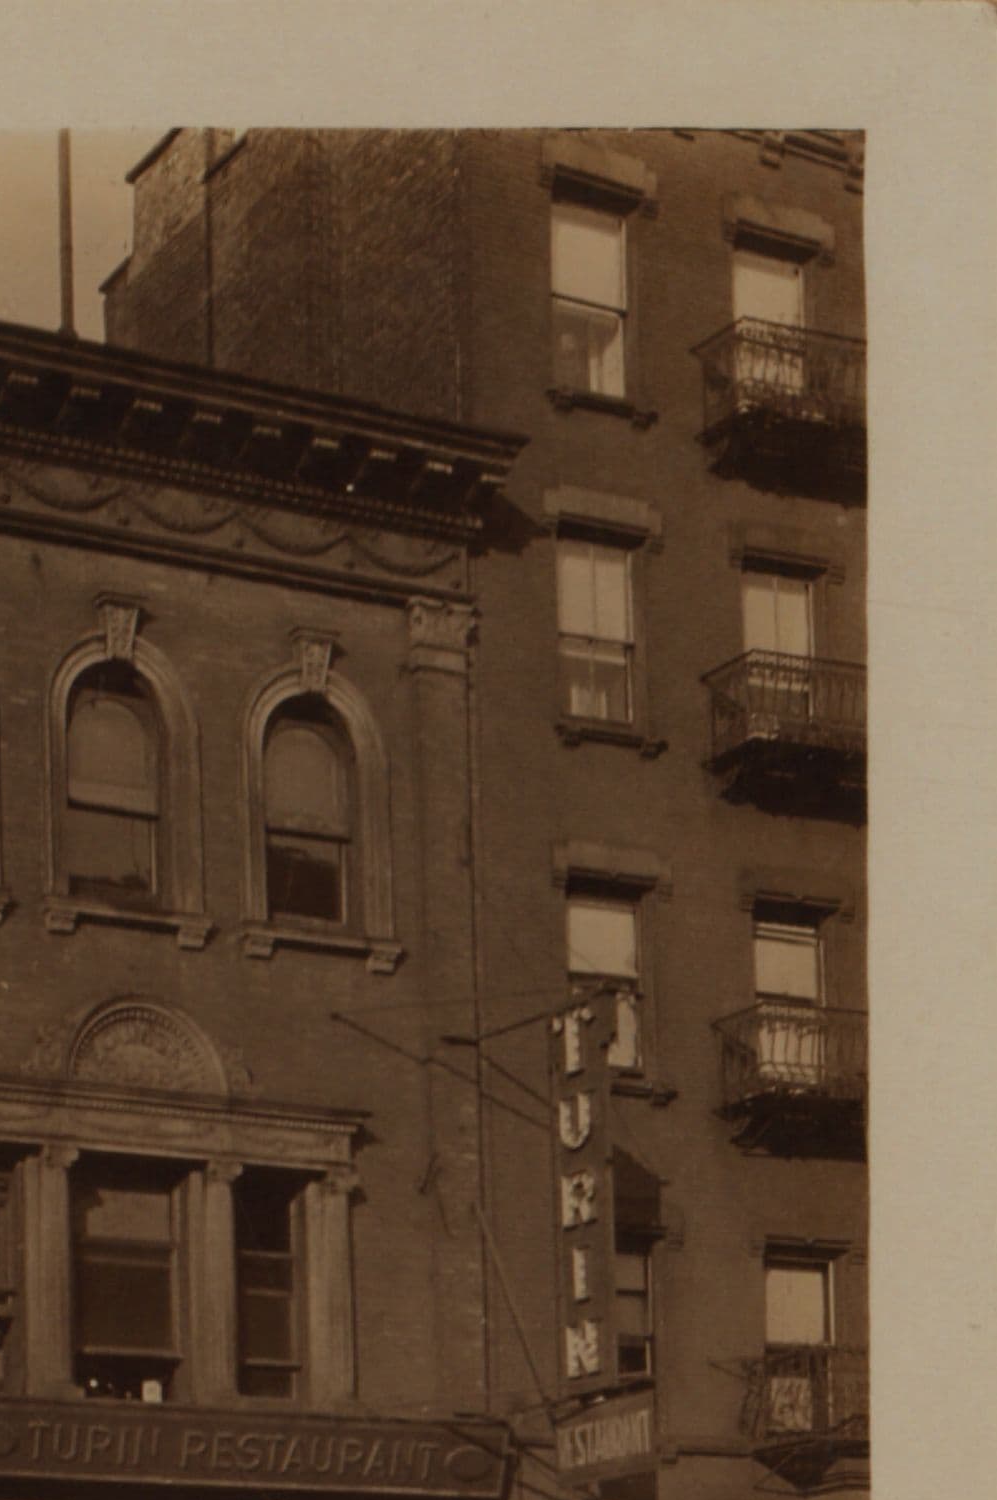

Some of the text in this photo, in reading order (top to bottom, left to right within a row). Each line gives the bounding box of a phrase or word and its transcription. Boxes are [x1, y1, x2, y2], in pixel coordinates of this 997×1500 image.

[554, 1005, 600, 1380] TURIN
[28, 1420, 438, 1482] TURIN RESTAURANT
